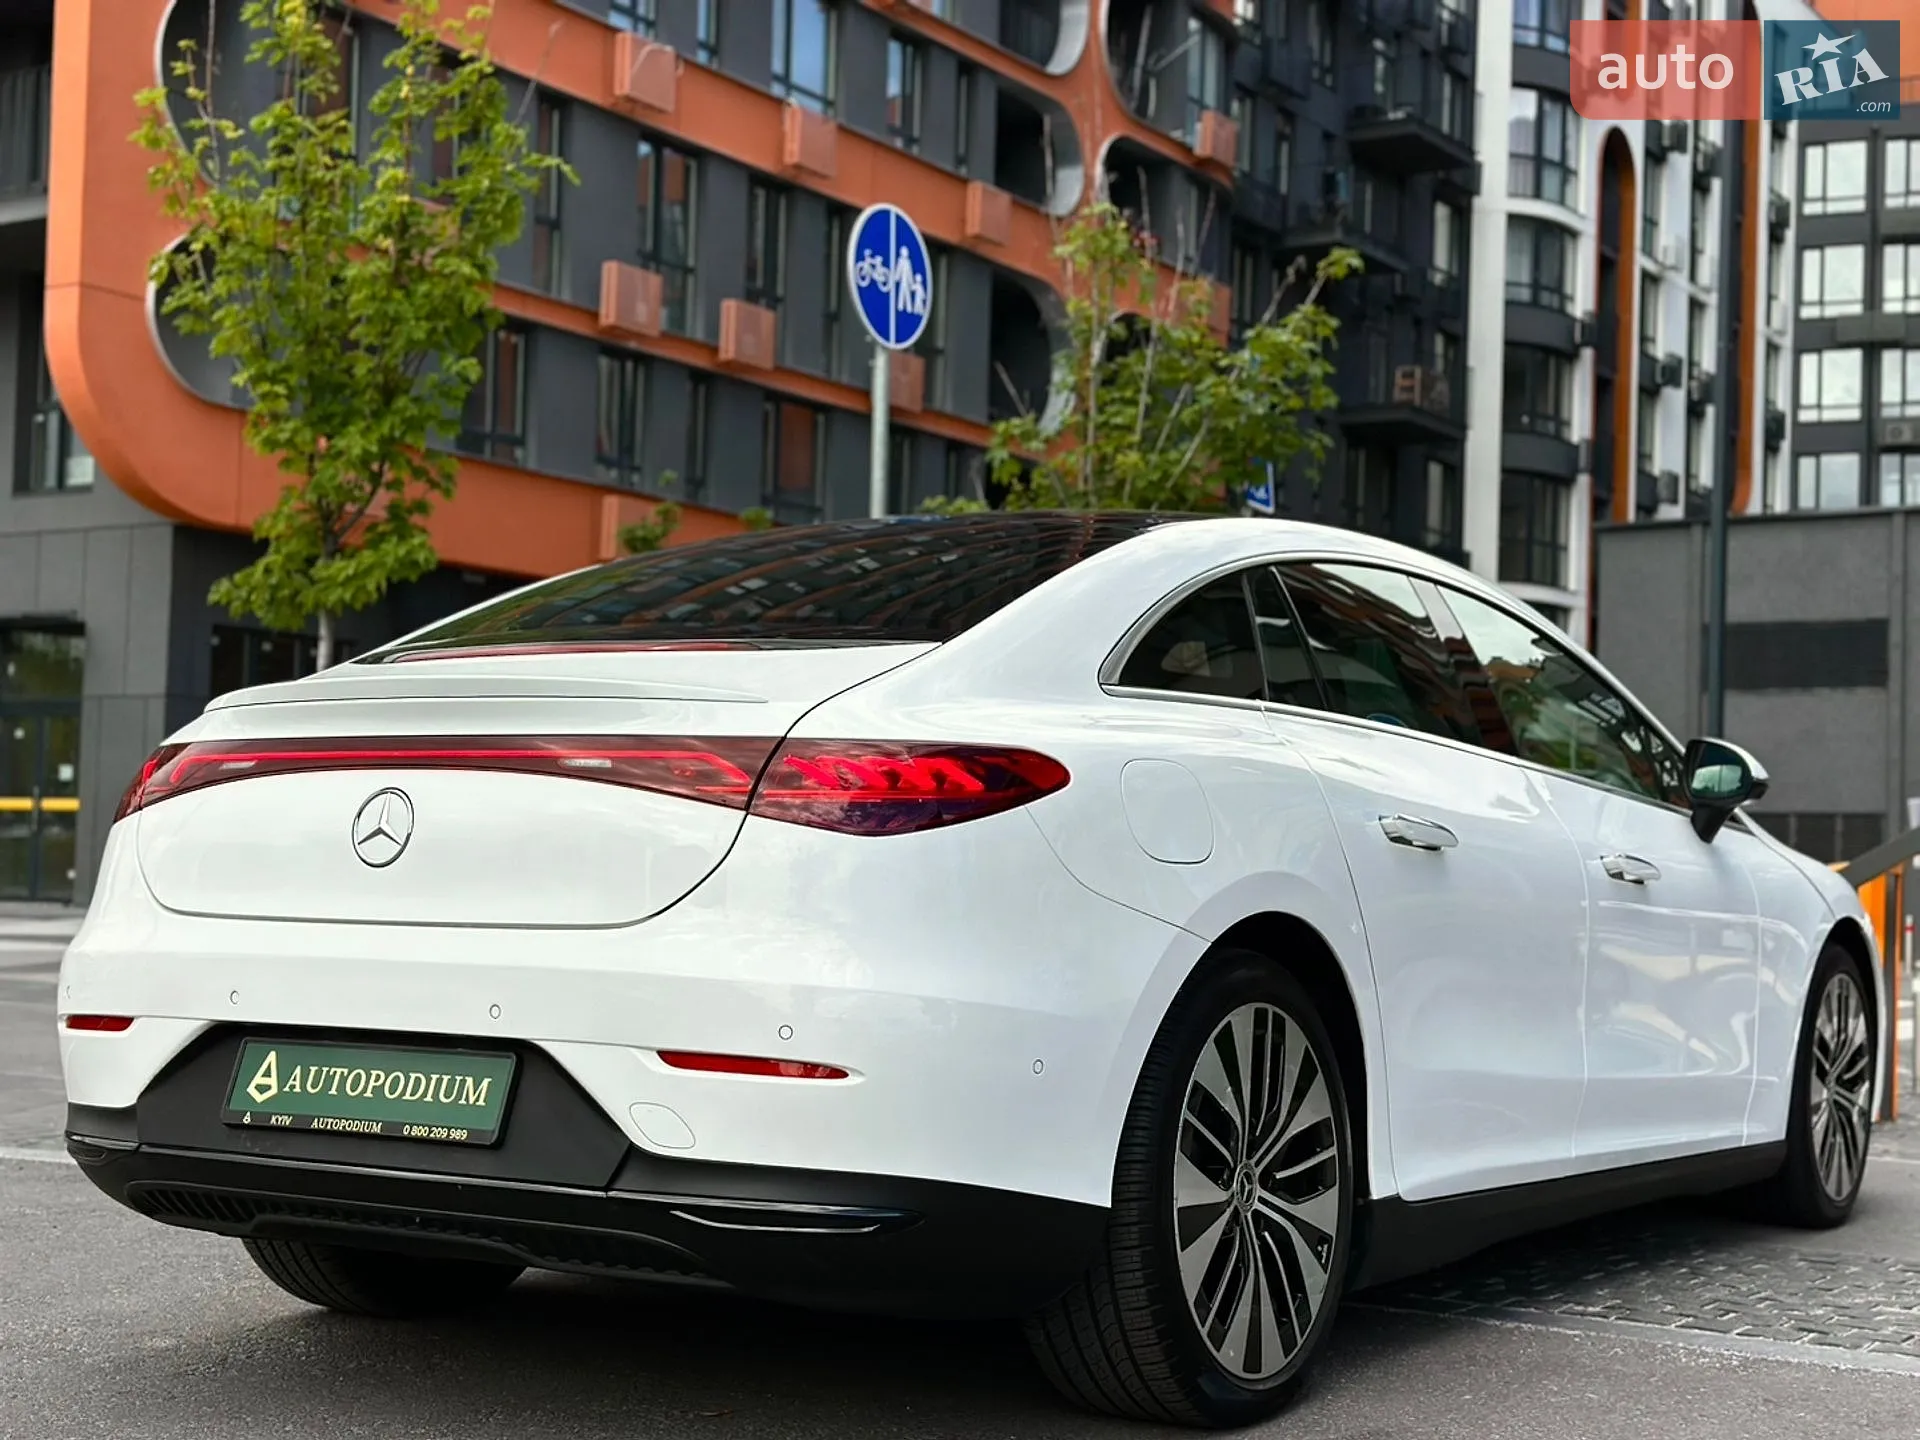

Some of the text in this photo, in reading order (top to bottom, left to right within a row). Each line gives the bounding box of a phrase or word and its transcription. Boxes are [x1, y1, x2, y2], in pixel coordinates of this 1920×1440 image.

[283, 1065, 492, 1106] AUTOPODIUM
[270, 1114, 293, 1126] KYIV
[310, 1117, 383, 1134] AUTOPODIUM
[411, 1125, 429, 1137] 800
[429, 1127, 448, 1139] 209
[449, 1128, 468, 1140] 989
